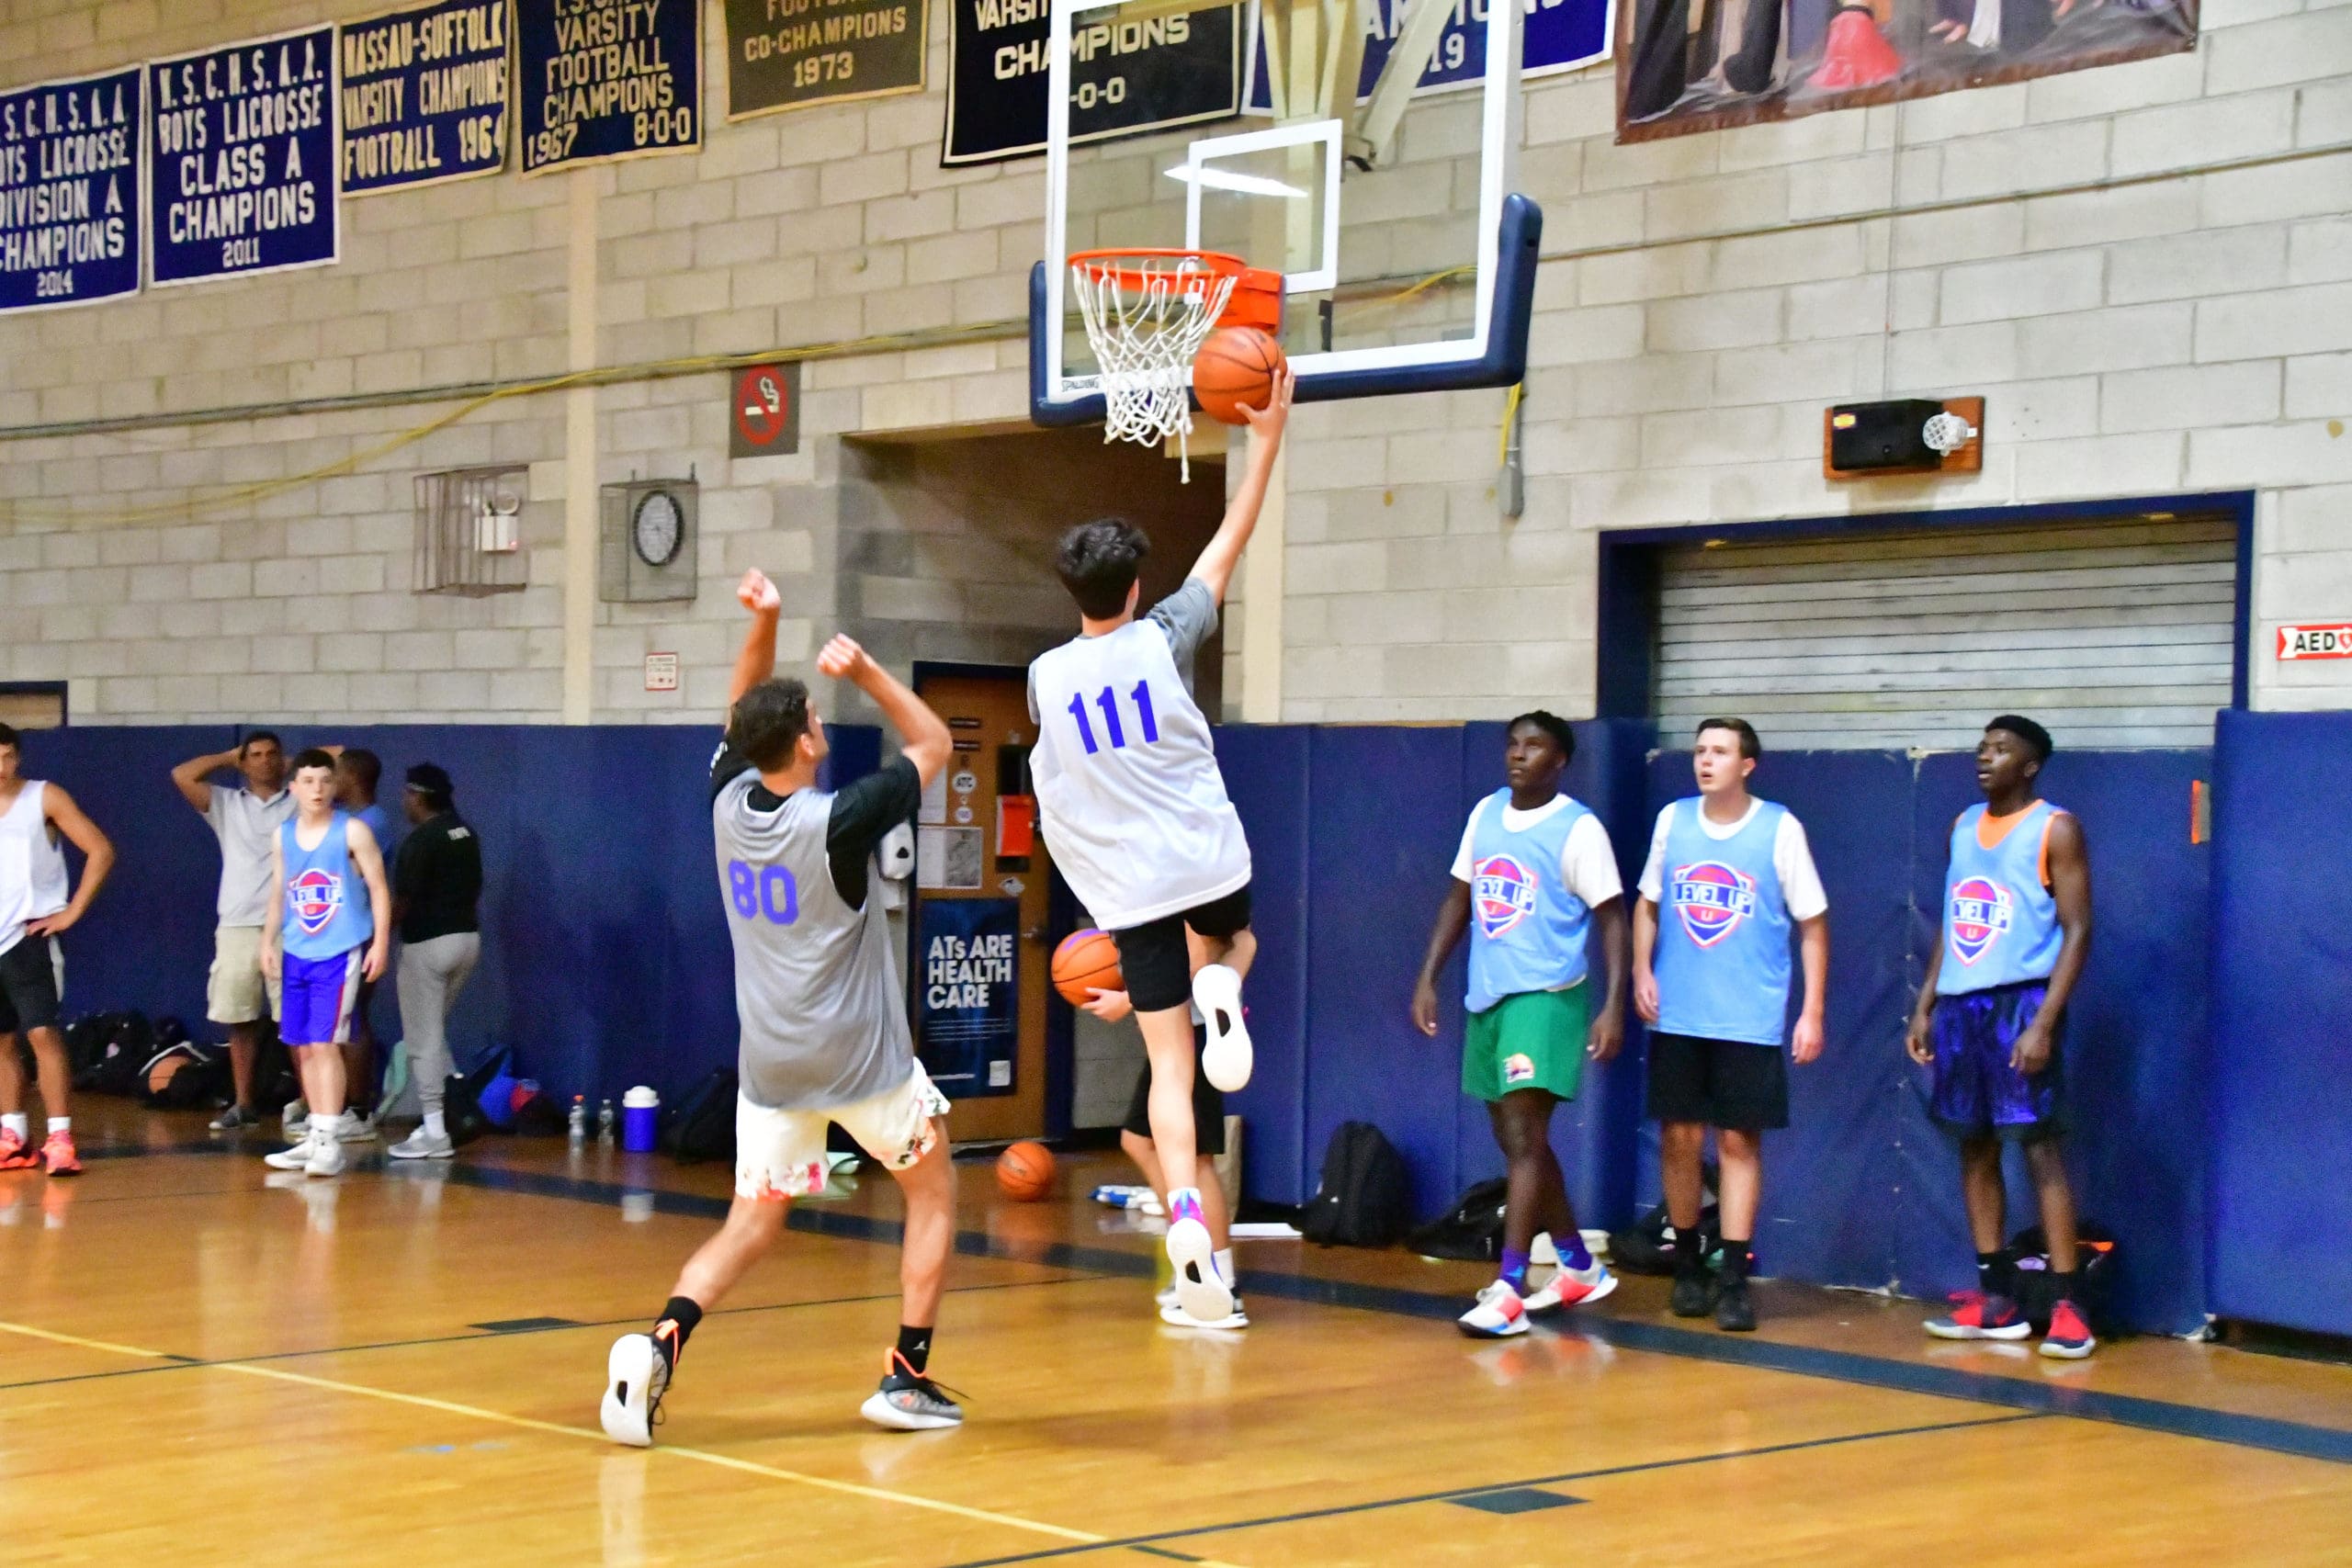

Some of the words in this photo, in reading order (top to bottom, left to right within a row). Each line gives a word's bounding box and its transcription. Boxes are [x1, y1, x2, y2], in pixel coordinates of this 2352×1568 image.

[554, 0, 661, 52] VARSITY
[744, 6, 907, 62] CO-CHAMPIONS
[546, 37, 669, 93] FOOTBALL
[794, 51, 854, 87] 1973
[158, 107, 207, 154] BOYS
[223, 84, 323, 143] LACROSSE
[344, 76, 404, 130] VARSITY
[419, 57, 504, 116] CHAMPIONS
[544, 73, 674, 129] CHAMPIONS
[180, 142, 266, 197] CLASS
[285, 136, 302, 179] A
[344, 124, 441, 182] FOOTBALL
[527, 121, 578, 168] 1967
[105, 174, 124, 213] A
[169, 181, 315, 243] CHAMPIONS
[0, 217, 125, 272] HAMPIONS
[222, 236, 260, 268] 2011
[37, 269, 74, 297] 2014
[2293, 632, 2335, 651] AED
[1068, 680, 1159, 754] 111
[729, 859, 798, 926] 80
[1728, 888, 1751, 912] UP
[928, 935, 966, 959] ATs
[969, 934, 1012, 958] ARE
[928, 958, 1012, 985] HEALTH
[927, 984, 989, 1010] CARE
